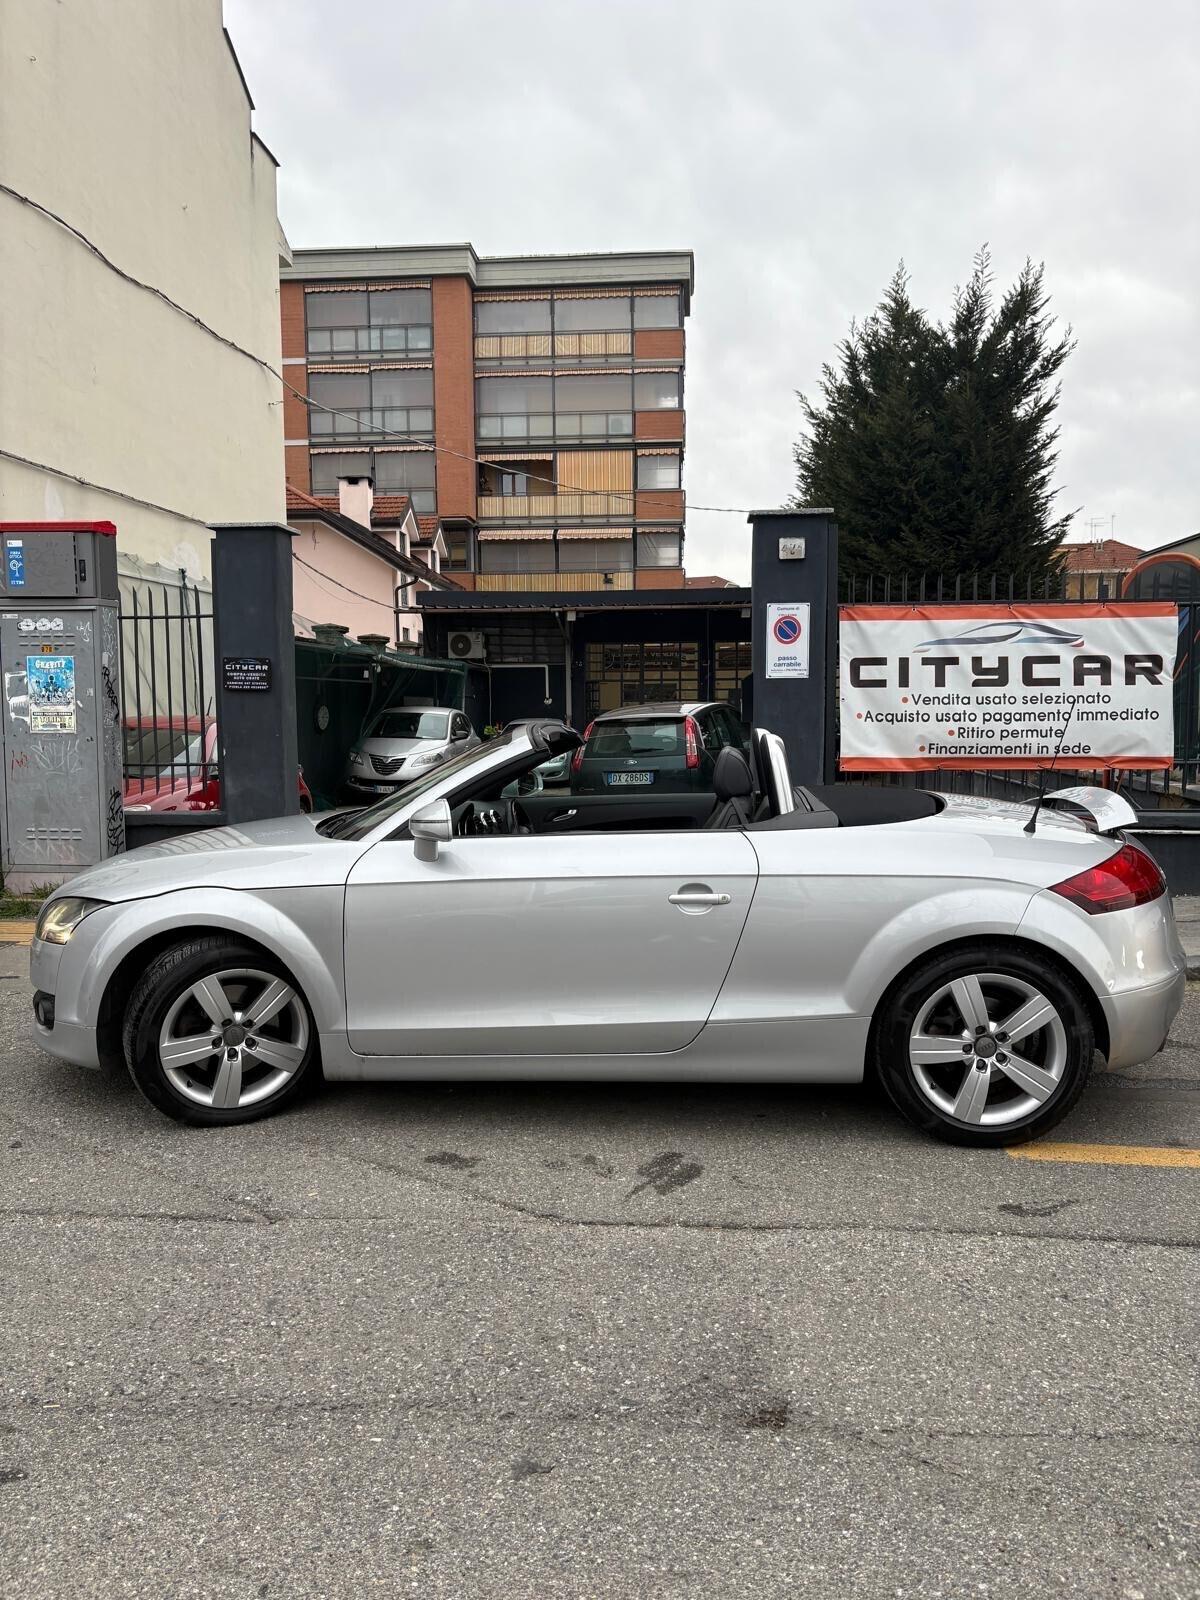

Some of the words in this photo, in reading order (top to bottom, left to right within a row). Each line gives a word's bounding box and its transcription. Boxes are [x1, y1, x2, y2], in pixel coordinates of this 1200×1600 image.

[849, 654, 1165, 689] CITYCAR
[911, 693, 971, 706] Vendita
[975, 693, 1017, 705] usato
[1021, 691, 1112, 705] selezionato
[864, 710, 931, 725] Acquisto
[935, 710, 978, 723] usato
[982, 708, 1072, 726] pagamento
[1076, 707, 1160, 722] immediato
[957, 726, 996, 739] Ritiro
[999, 728, 1065, 740] permute
[928, 742, 1032, 755] Finanziamenti
[1036, 742, 1049, 755] in
[1053, 742, 1092, 755] sede
